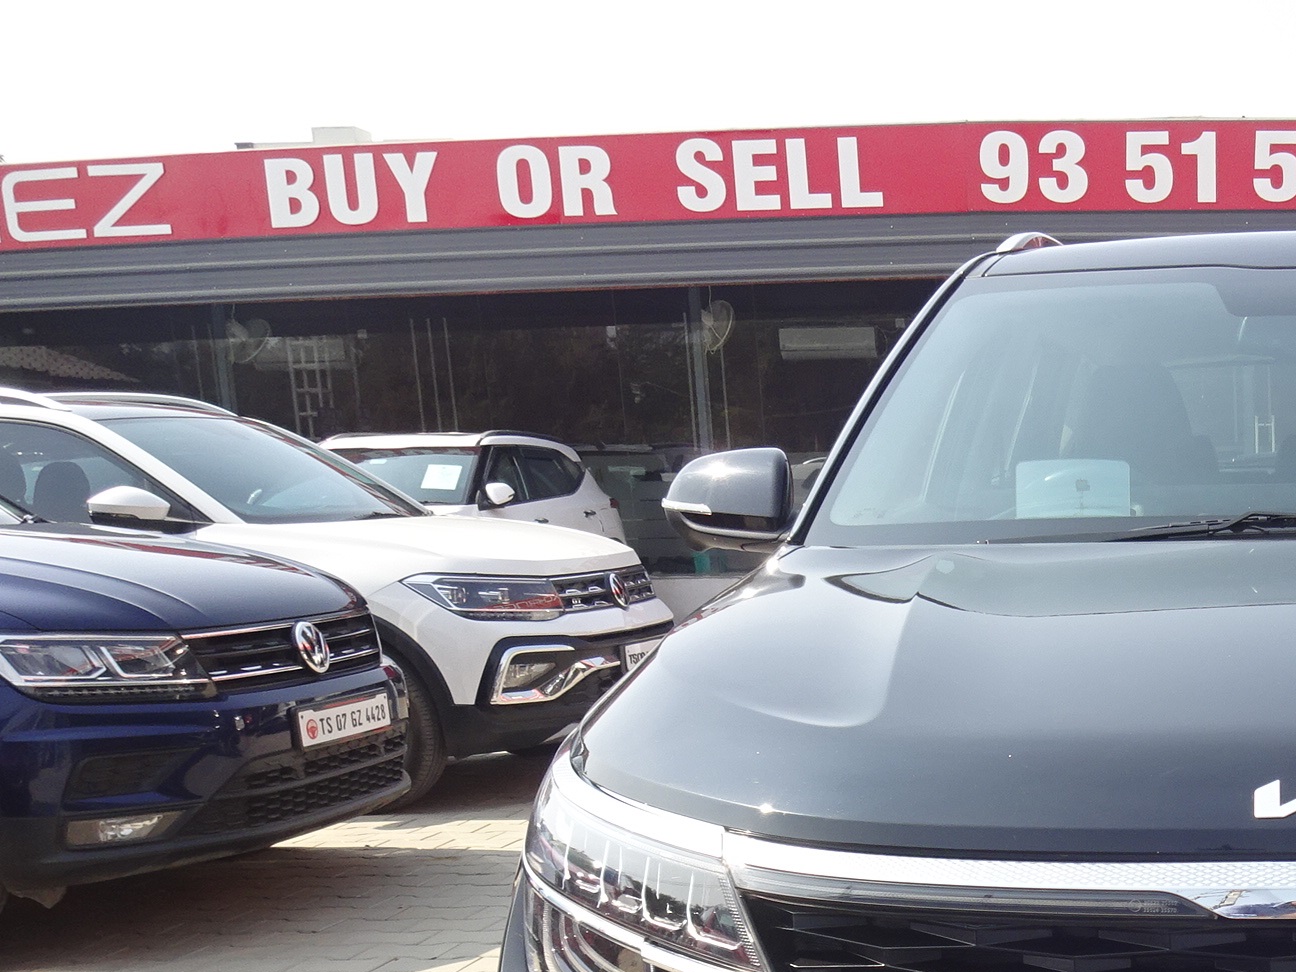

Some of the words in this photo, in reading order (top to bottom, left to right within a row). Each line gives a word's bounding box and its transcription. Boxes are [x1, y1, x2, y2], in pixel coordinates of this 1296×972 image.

[263, 152, 438, 228] BUY
[496, 145, 618, 218] OR
[675, 137, 884, 212] SELL
[979, 130, 1089, 204] 93
[1124, 131, 1217, 203] 51
[319, 717, 333, 735] TS
[335, 713, 347, 731] 07
[365, 703, 387, 724] 4428
